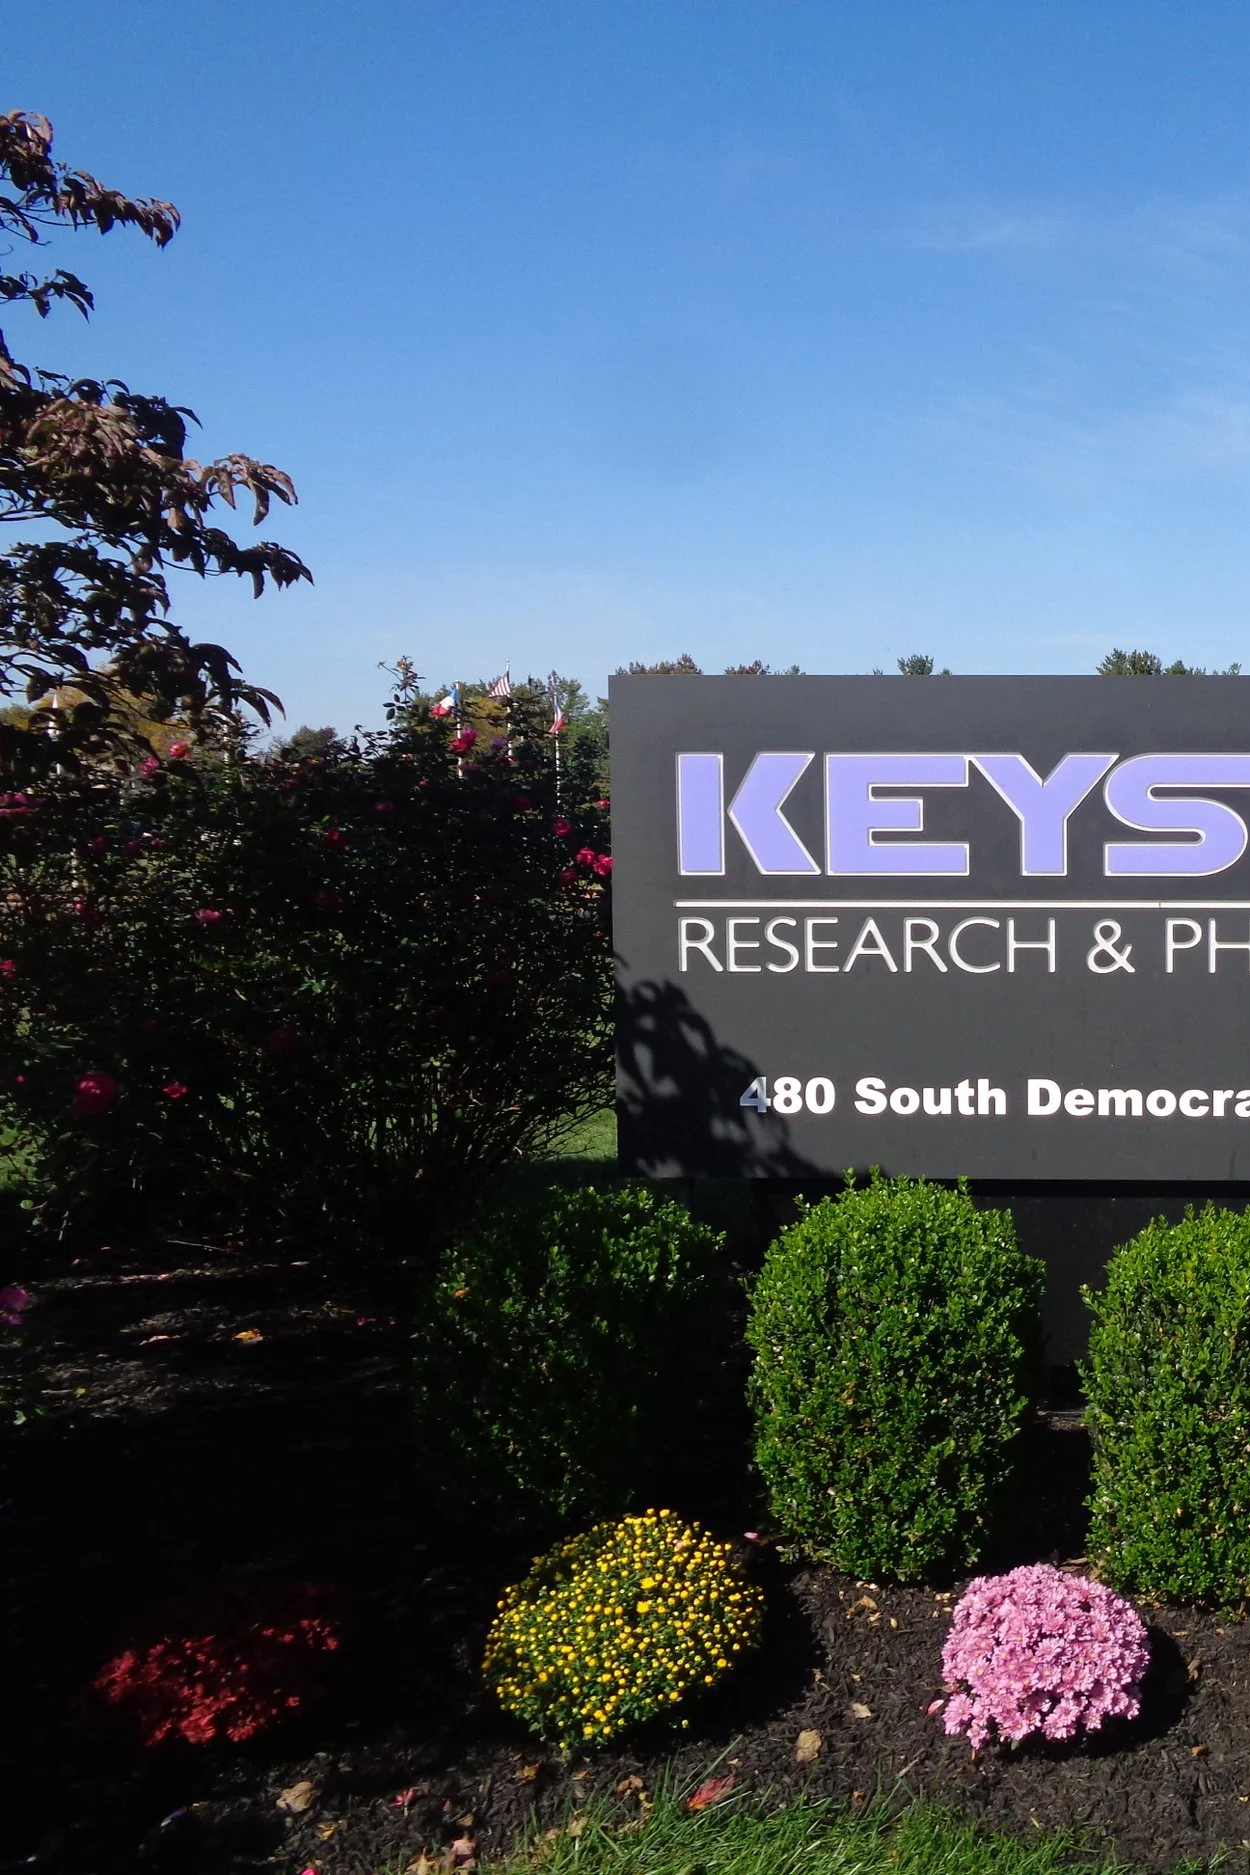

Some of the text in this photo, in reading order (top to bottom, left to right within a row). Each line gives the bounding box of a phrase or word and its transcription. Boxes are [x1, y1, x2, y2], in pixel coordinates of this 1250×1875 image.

[677, 916, 1057, 974] RESEARCH
[1085, 918, 1136, 975] &
[739, 1076, 836, 1115] 480
[853, 1076, 1007, 1116] South
